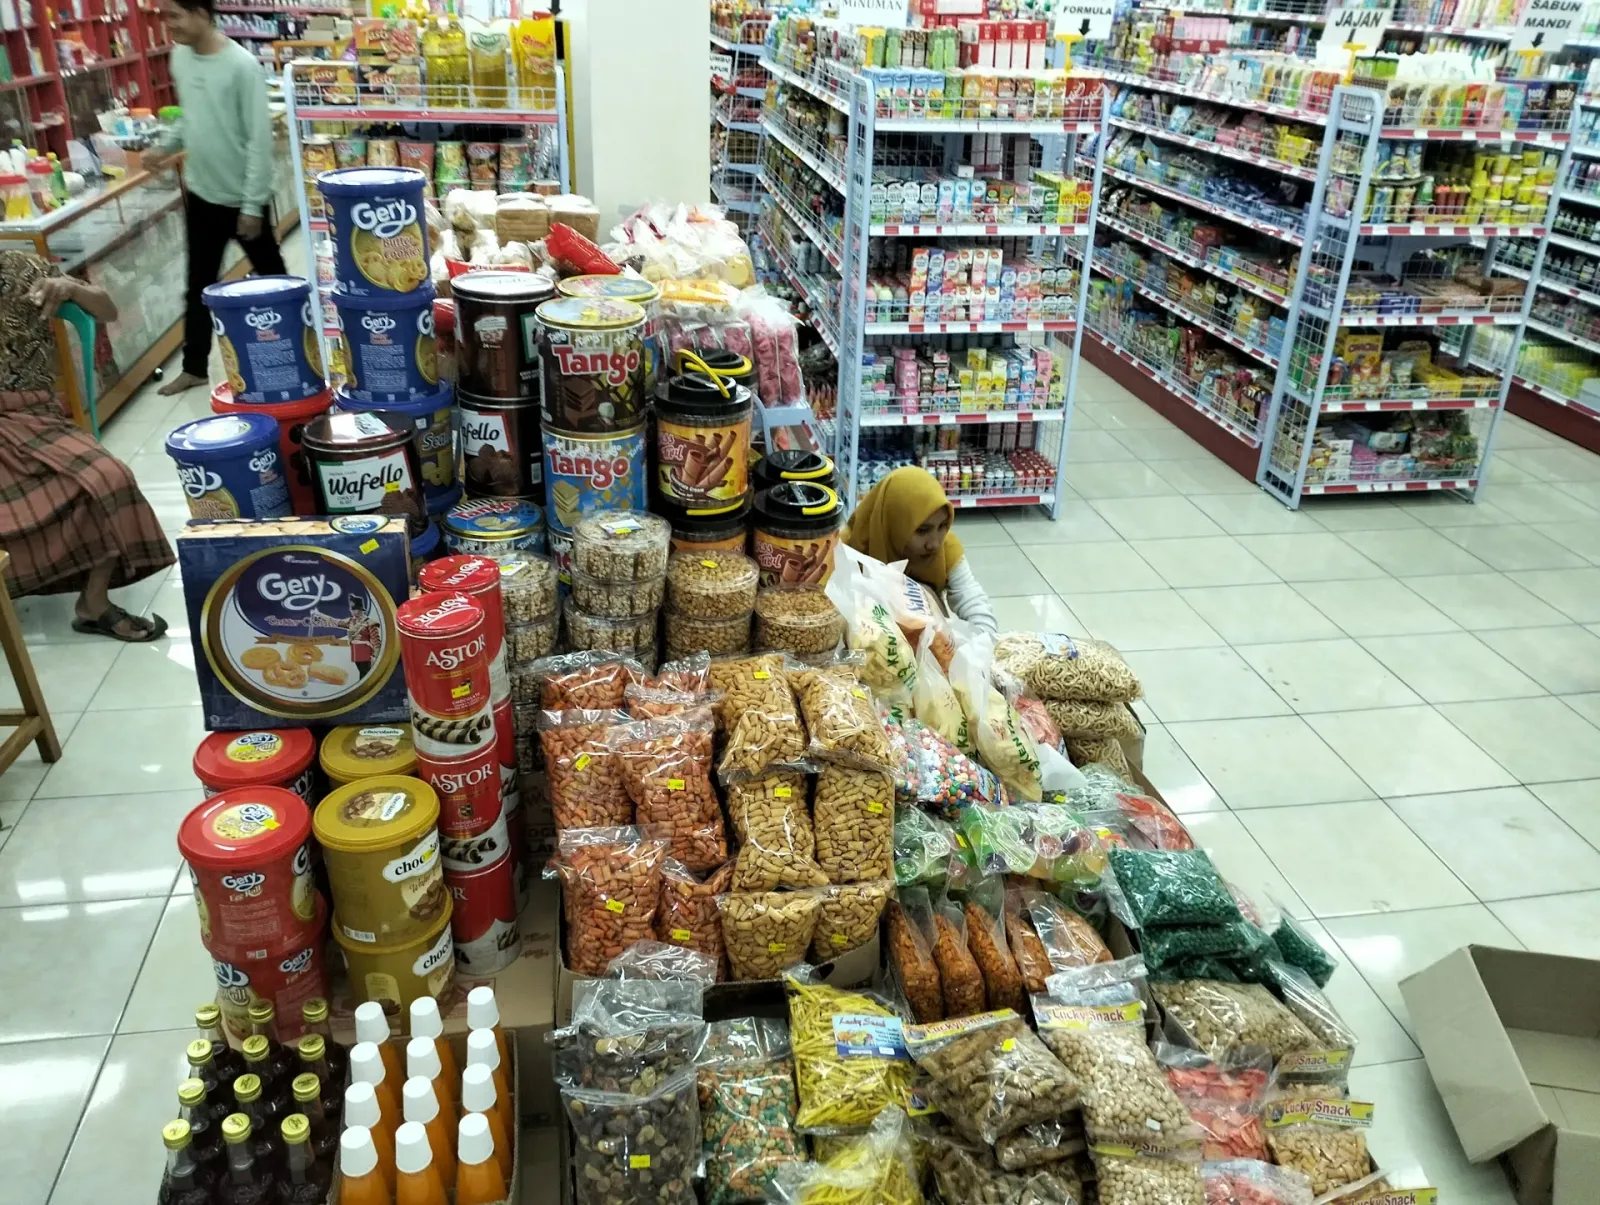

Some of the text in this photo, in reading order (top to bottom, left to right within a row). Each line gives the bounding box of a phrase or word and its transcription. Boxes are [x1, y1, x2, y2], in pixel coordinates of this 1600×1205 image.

[843, 0, 903, 11] MINUMAN
[1062, 5, 1112, 15] FORMULA
[1531, 0, 1582, 12] SABUN
[1335, 11, 1384, 28] JAJAN
[1525, 17, 1572, 30] MANDI
[710, 55, 731, 63] UMBU
[710, 64, 729, 72] APUR
[350, 198, 418, 239] Gery
[245, 308, 282, 330] Gery
[361, 313, 396, 334] Gery
[551, 344, 640, 386] Tango
[461, 422, 500, 443] fello
[249, 451, 277, 473] Gery
[547, 448, 631, 490] Tango
[328, 463, 404, 501] Wafello
[447, 500, 519, 521] Tango
[443, 557, 485, 586] ASTOR
[256, 572, 343, 611] Gery
[417, 591, 470, 625] ASTOR
[425, 633, 487, 671] ASTOR
[236, 732, 280, 746] Gery
[429, 763, 493, 794] ASTOR
[221, 872, 266, 892] Gery
[280, 948, 314, 973] Gery
[1051, 1007, 1125, 1024] Lucky Snack
[925, 1018, 959, 1036] Lucky
[1298, 1053, 1328, 1066] Snack
[1285, 1099, 1352, 1117] Lucky Snack
[1383, 1192, 1416, 1205] Snack
